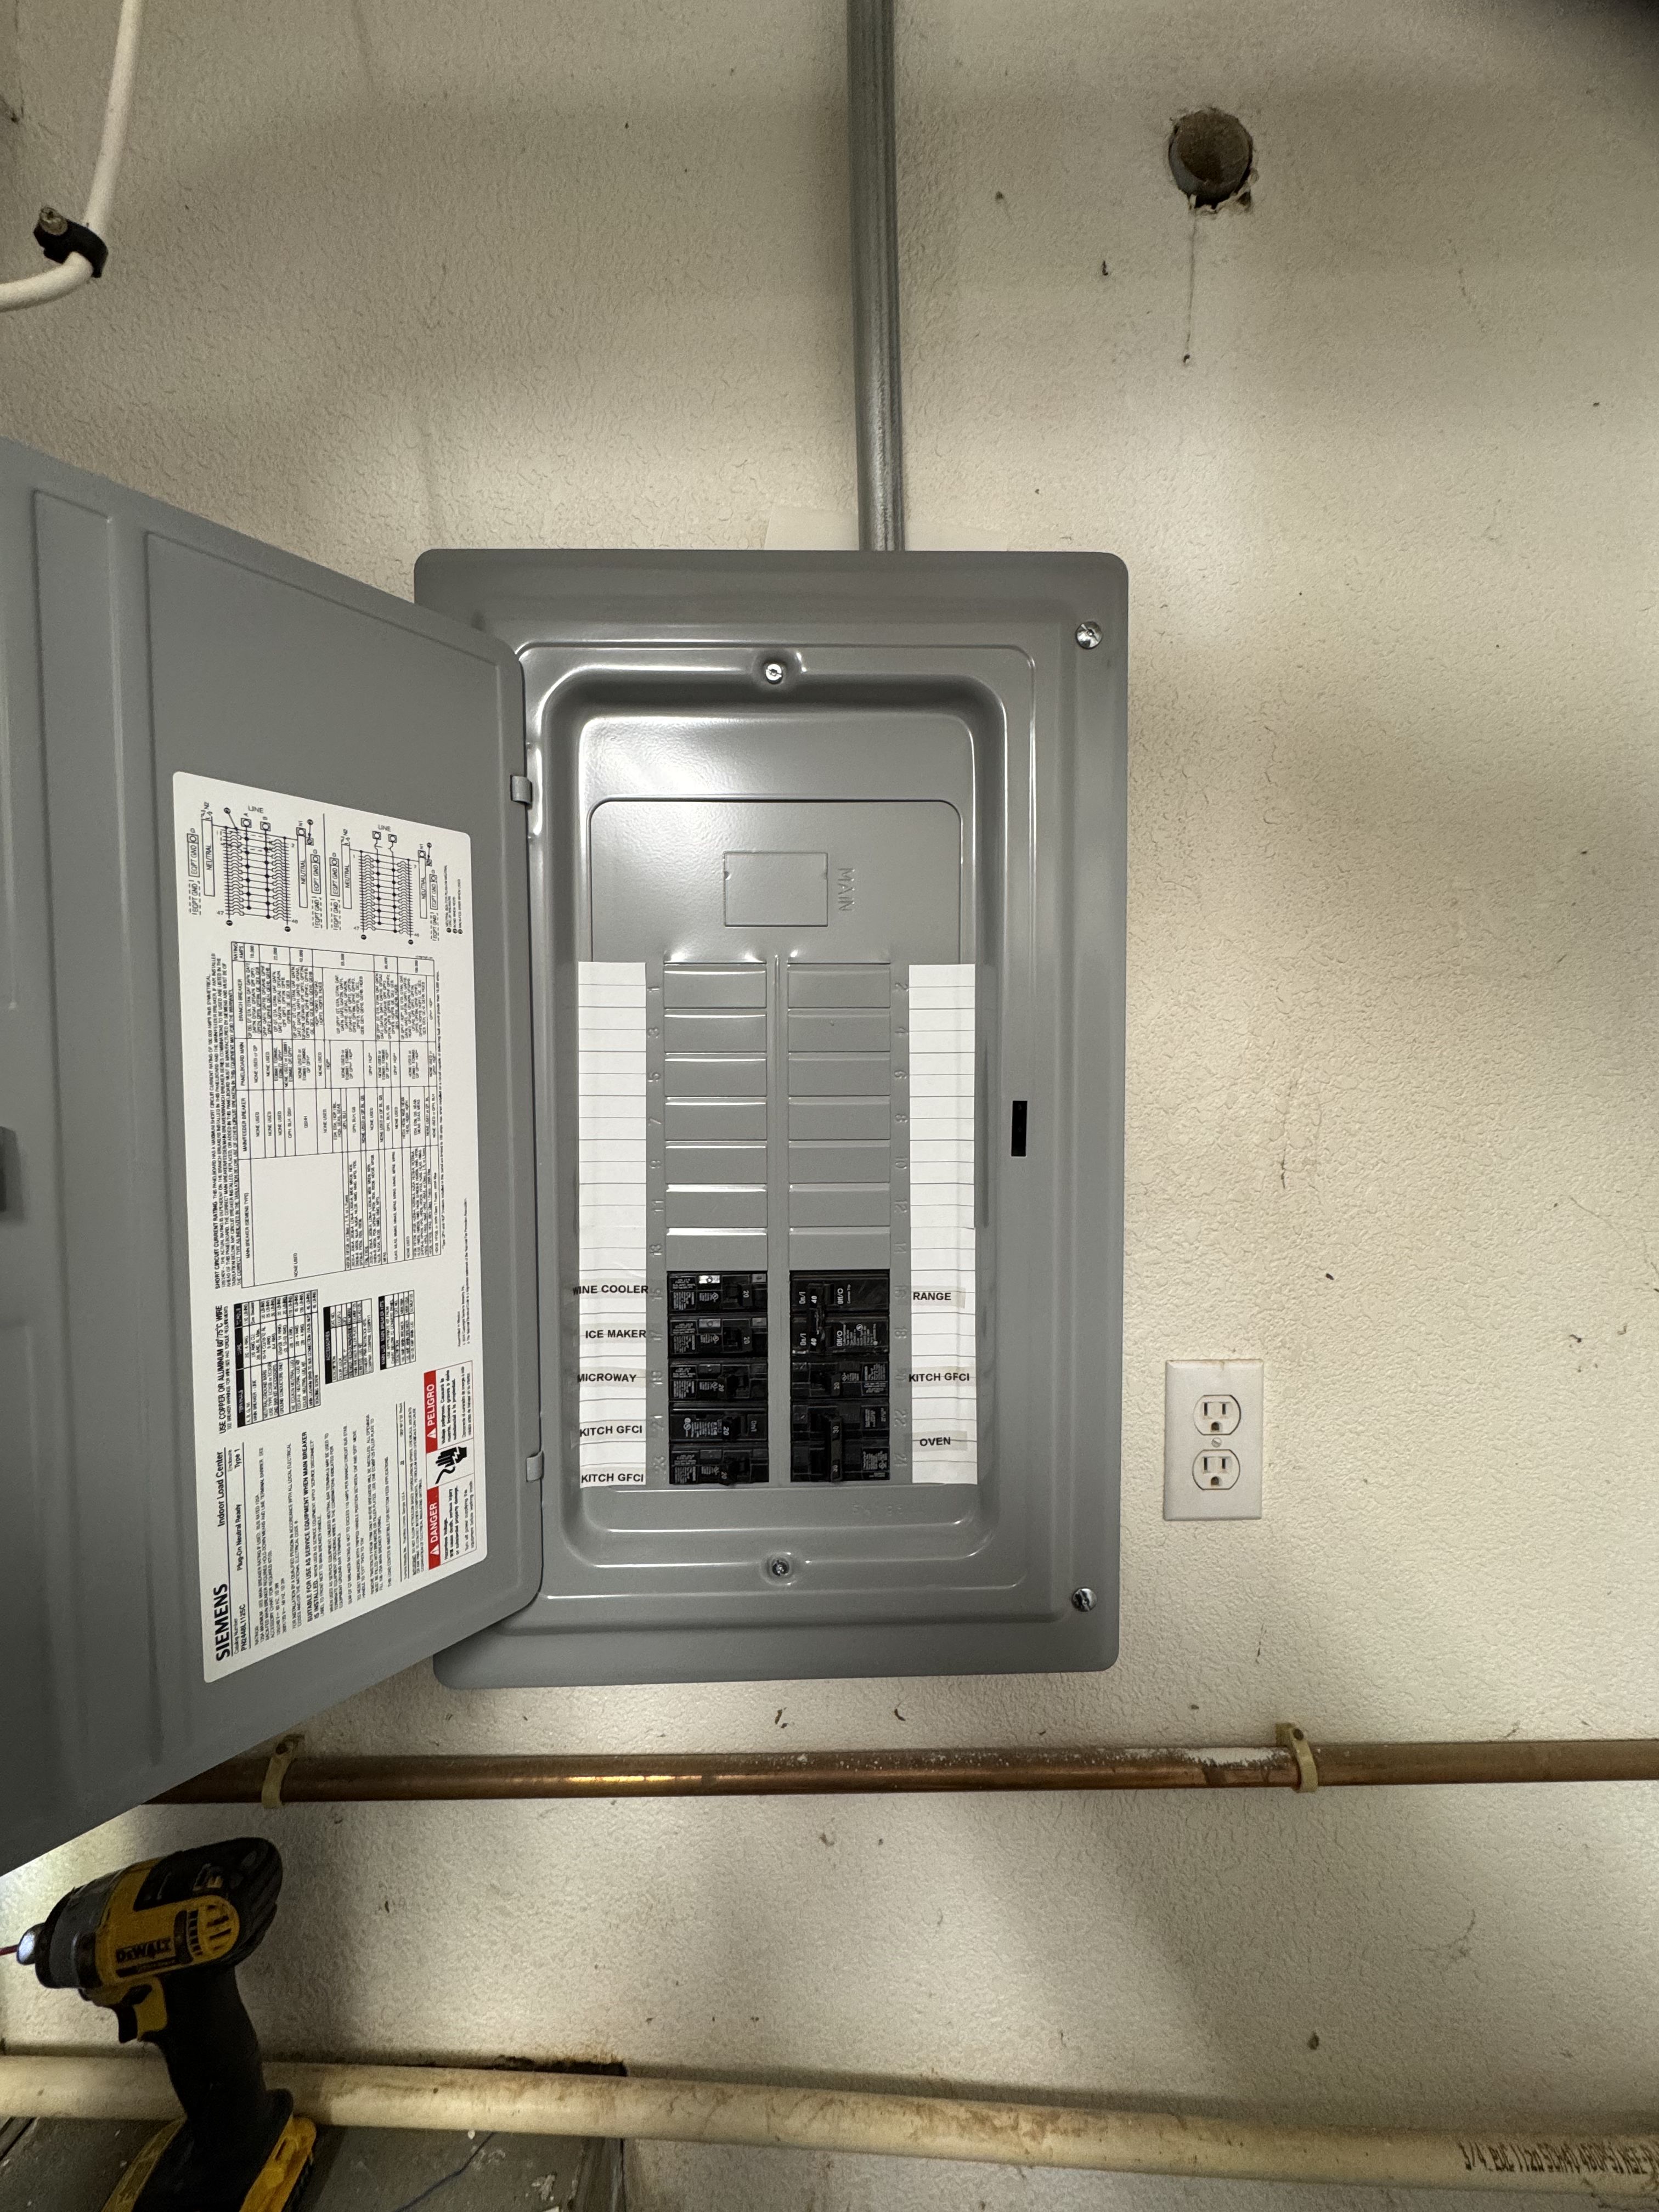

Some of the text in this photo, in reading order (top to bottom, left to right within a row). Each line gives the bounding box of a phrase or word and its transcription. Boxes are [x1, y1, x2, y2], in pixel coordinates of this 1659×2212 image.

[248, 805, 263, 814] LINE
[377, 824, 391, 832] LINE
[837, 867, 855, 912] MAIN
[573, 1284, 649, 1295] WINE COOLER
[743, 1290, 750, 1298] 20
[811, 1295, 818, 1304] 40
[913, 1292, 952, 1301] RANGE
[585, 1329, 646, 1339] ICE MAKER
[743, 1336, 751, 1345] 20
[810, 1337, 817, 1346] 40
[216, 1348, 224, 1382] ALUMINUM
[577, 1373, 637, 1383] MICROWAY
[909, 1372, 970, 1382] KITCH GFCI
[217, 1383, 224, 1393] OR
[718, 1383, 725, 1392] 20
[833, 1381, 840, 1390] 20
[426, 1384, 435, 1427] PELIGRO
[579, 1425, 642, 1437] KITCH GFCI
[723, 1426, 730, 1436] 20
[832, 1425, 839, 1434] 30
[919, 1437, 951, 1447] OVEN
[215, 1451, 223, 1479] Center
[234, 1453, 242, 1469] Type
[582, 1472, 644, 1483] KITCH GFCI
[721, 1471, 727, 1480] 20
[217, 1500, 225, 1527] Indoor
[429, 1502, 438, 1544] DANGER
[305, 1558, 311, 1567] AS
[213, 1582, 230, 1663] SIEMENS
[239, 1604, 247, 1652] PN2448L1125C
